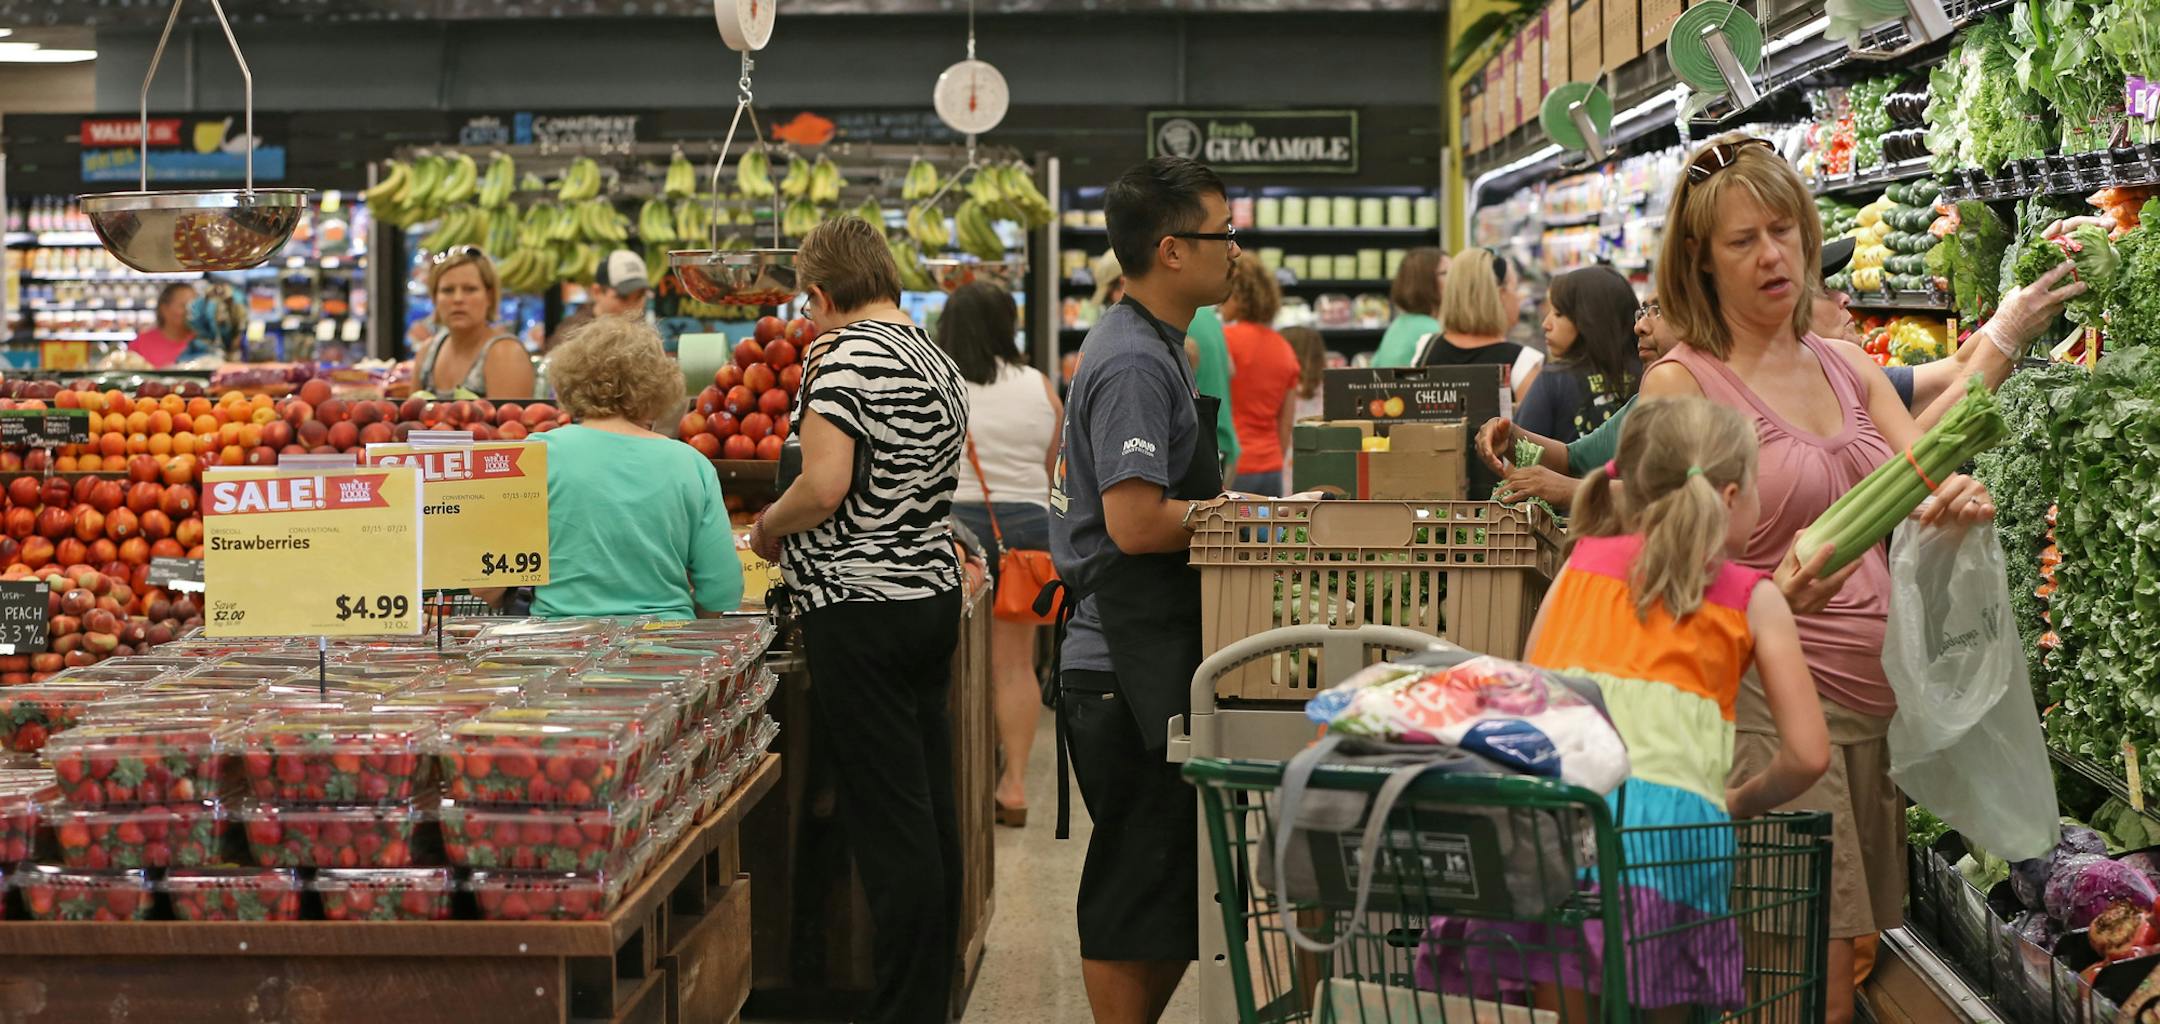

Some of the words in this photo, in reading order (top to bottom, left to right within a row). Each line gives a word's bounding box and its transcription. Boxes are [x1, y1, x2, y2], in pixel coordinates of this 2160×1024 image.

[1208, 121, 1255, 137] fresh
[1205, 136, 1350, 162] GUACAMOLE
[1415, 390, 1457, 404] CHELAN
[484, 453, 510, 463] WHOLE
[339, 479, 371, 491] WHOLE
[213, 475, 326, 513] SALE!
[341, 490, 371, 498] FOODS
[423, 502, 460, 514] erries
[211, 535, 310, 550] Strawberries
[481, 552, 542, 576] $4.99
[756, 561, 772, 569] Plu
[213, 600, 237, 610] Save
[336, 594, 409, 621] $4.99
[4, 606, 43, 620] PEACH
[214, 610, 245, 621] $2.00
[383, 621, 392, 629] 32
[396, 621, 408, 629] OZ
